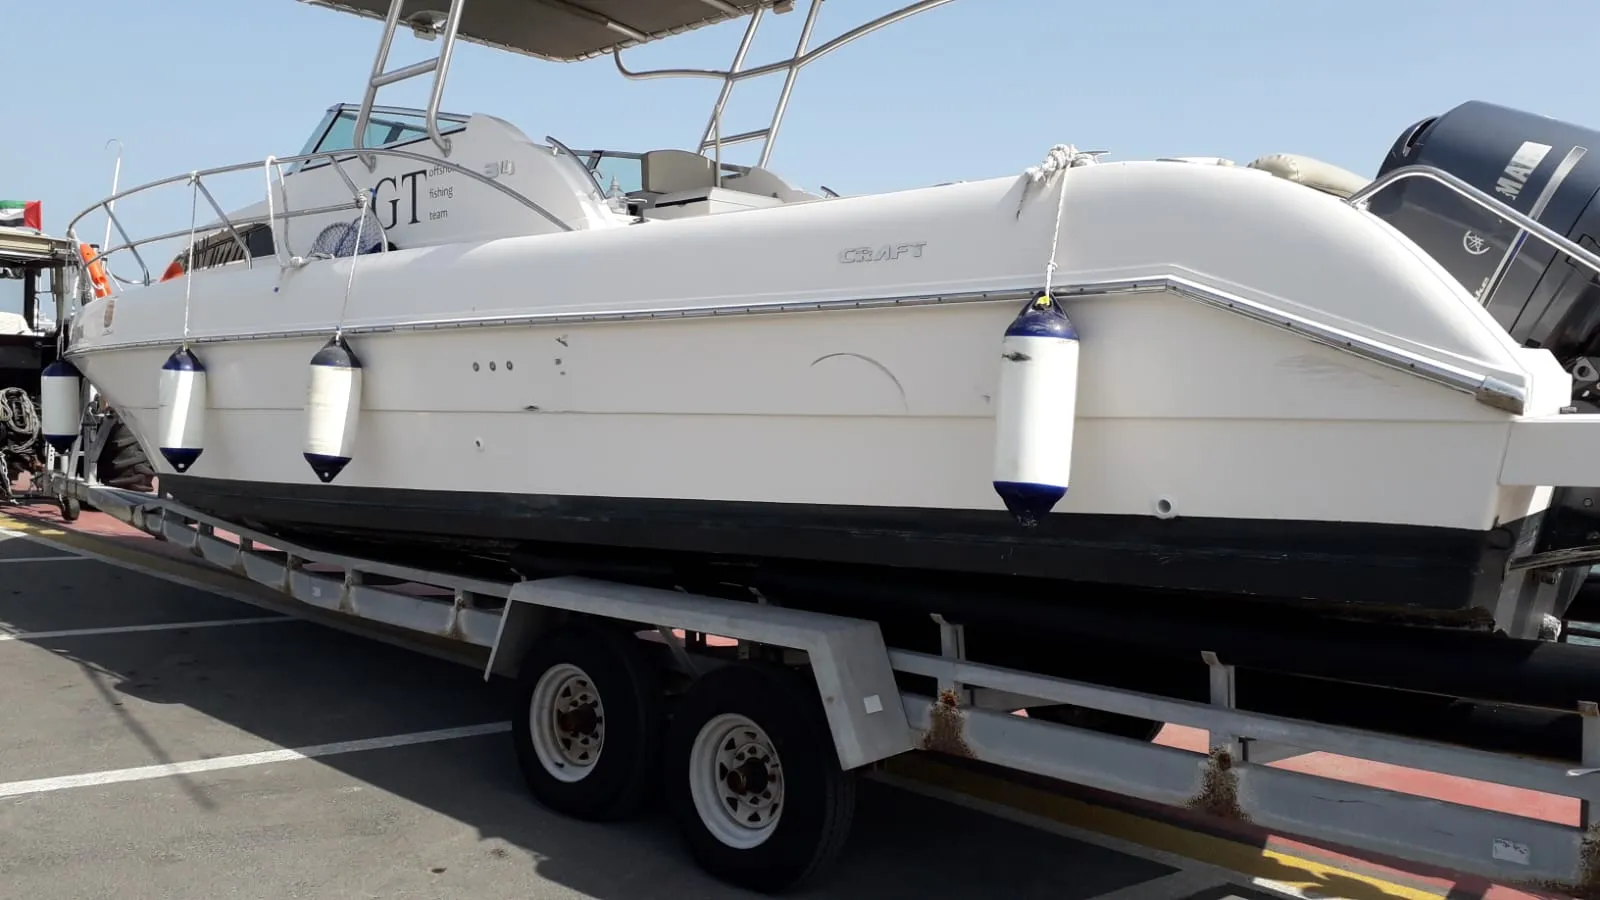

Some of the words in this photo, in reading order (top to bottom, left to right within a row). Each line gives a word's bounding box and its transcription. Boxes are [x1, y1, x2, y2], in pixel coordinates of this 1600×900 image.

[371, 169, 427, 230] GT
[429, 185, 454, 200] fishing
[429, 208, 449, 222] team
[839, 242, 928, 264] CRAFT
